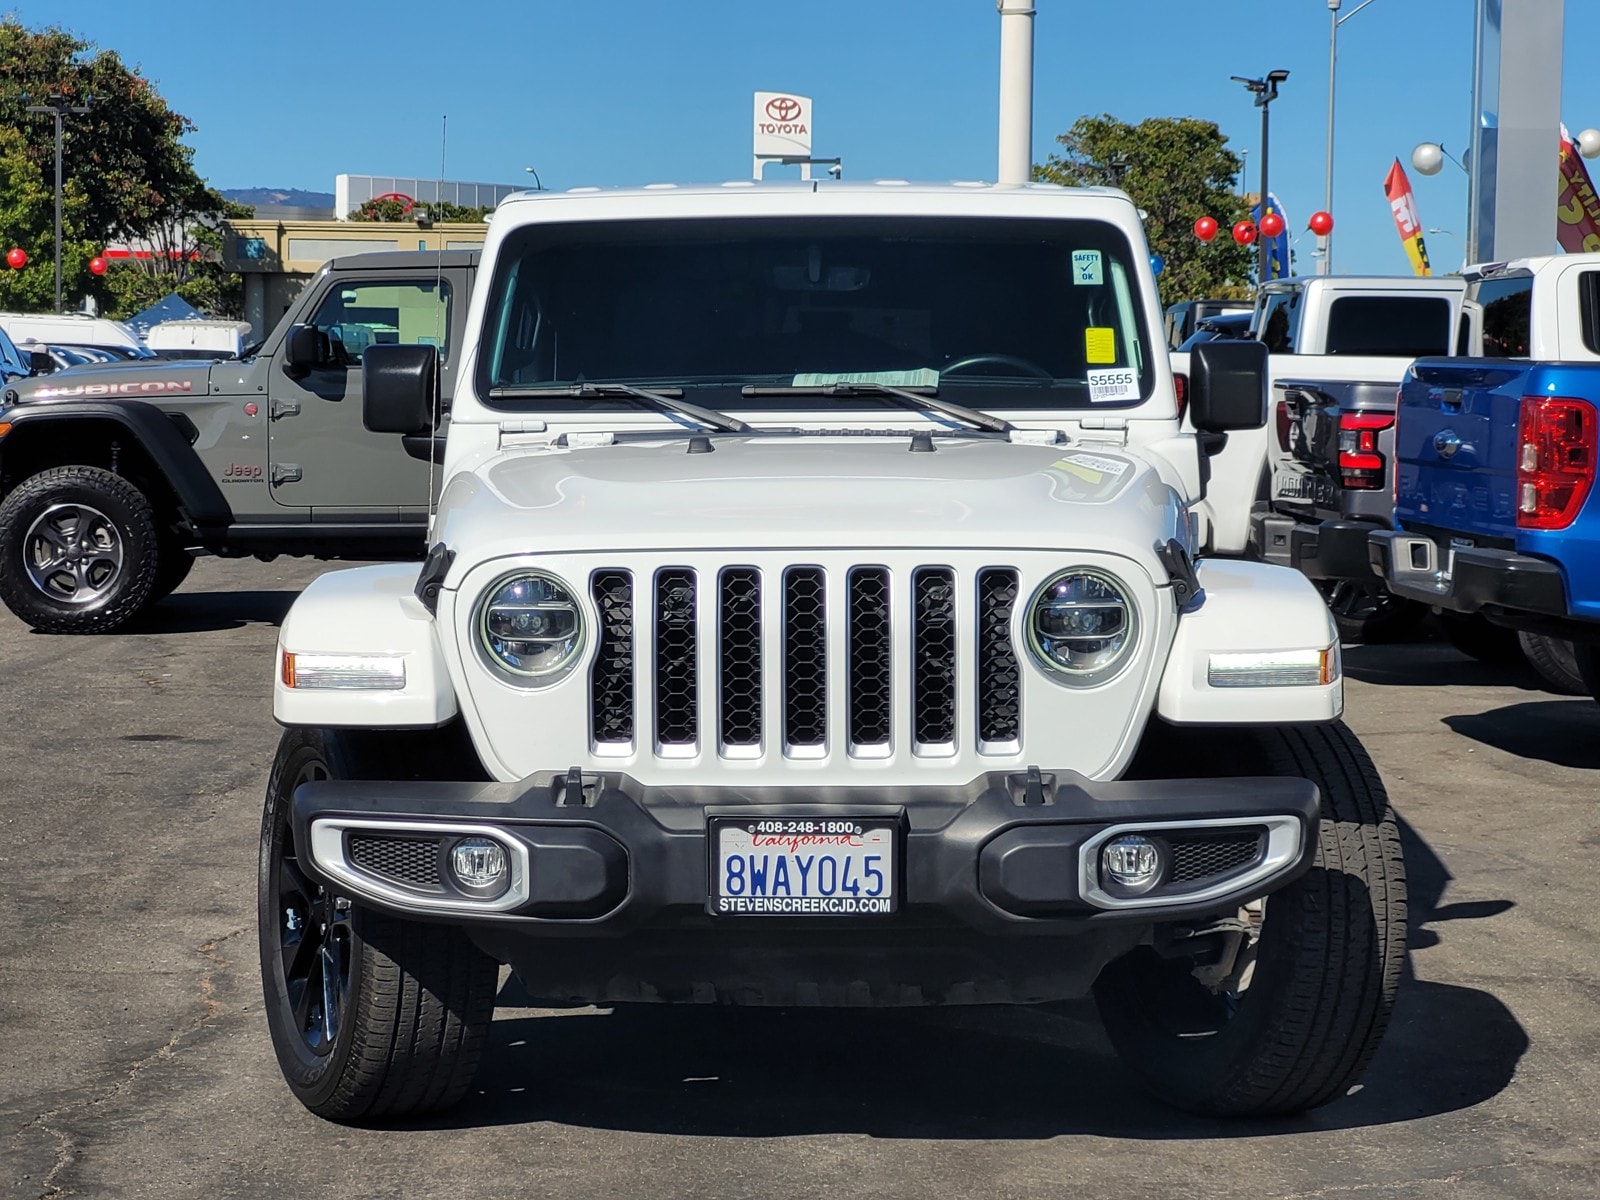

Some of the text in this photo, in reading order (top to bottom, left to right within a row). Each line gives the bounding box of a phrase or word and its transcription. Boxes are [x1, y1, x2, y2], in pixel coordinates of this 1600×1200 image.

[758, 123, 808, 135] TOYOTA
[1074, 254, 1099, 262] SAFETY
[1081, 273, 1094, 281] OK
[1090, 373, 1133, 386] S5555
[223, 462, 263, 479] Jeep
[756, 821, 854, 834] 408-248-1800
[752, 834, 864, 853] California
[726, 854, 884, 897] 8WAY045
[719, 897, 891, 913] STEVENSCREEKCJD.COM
